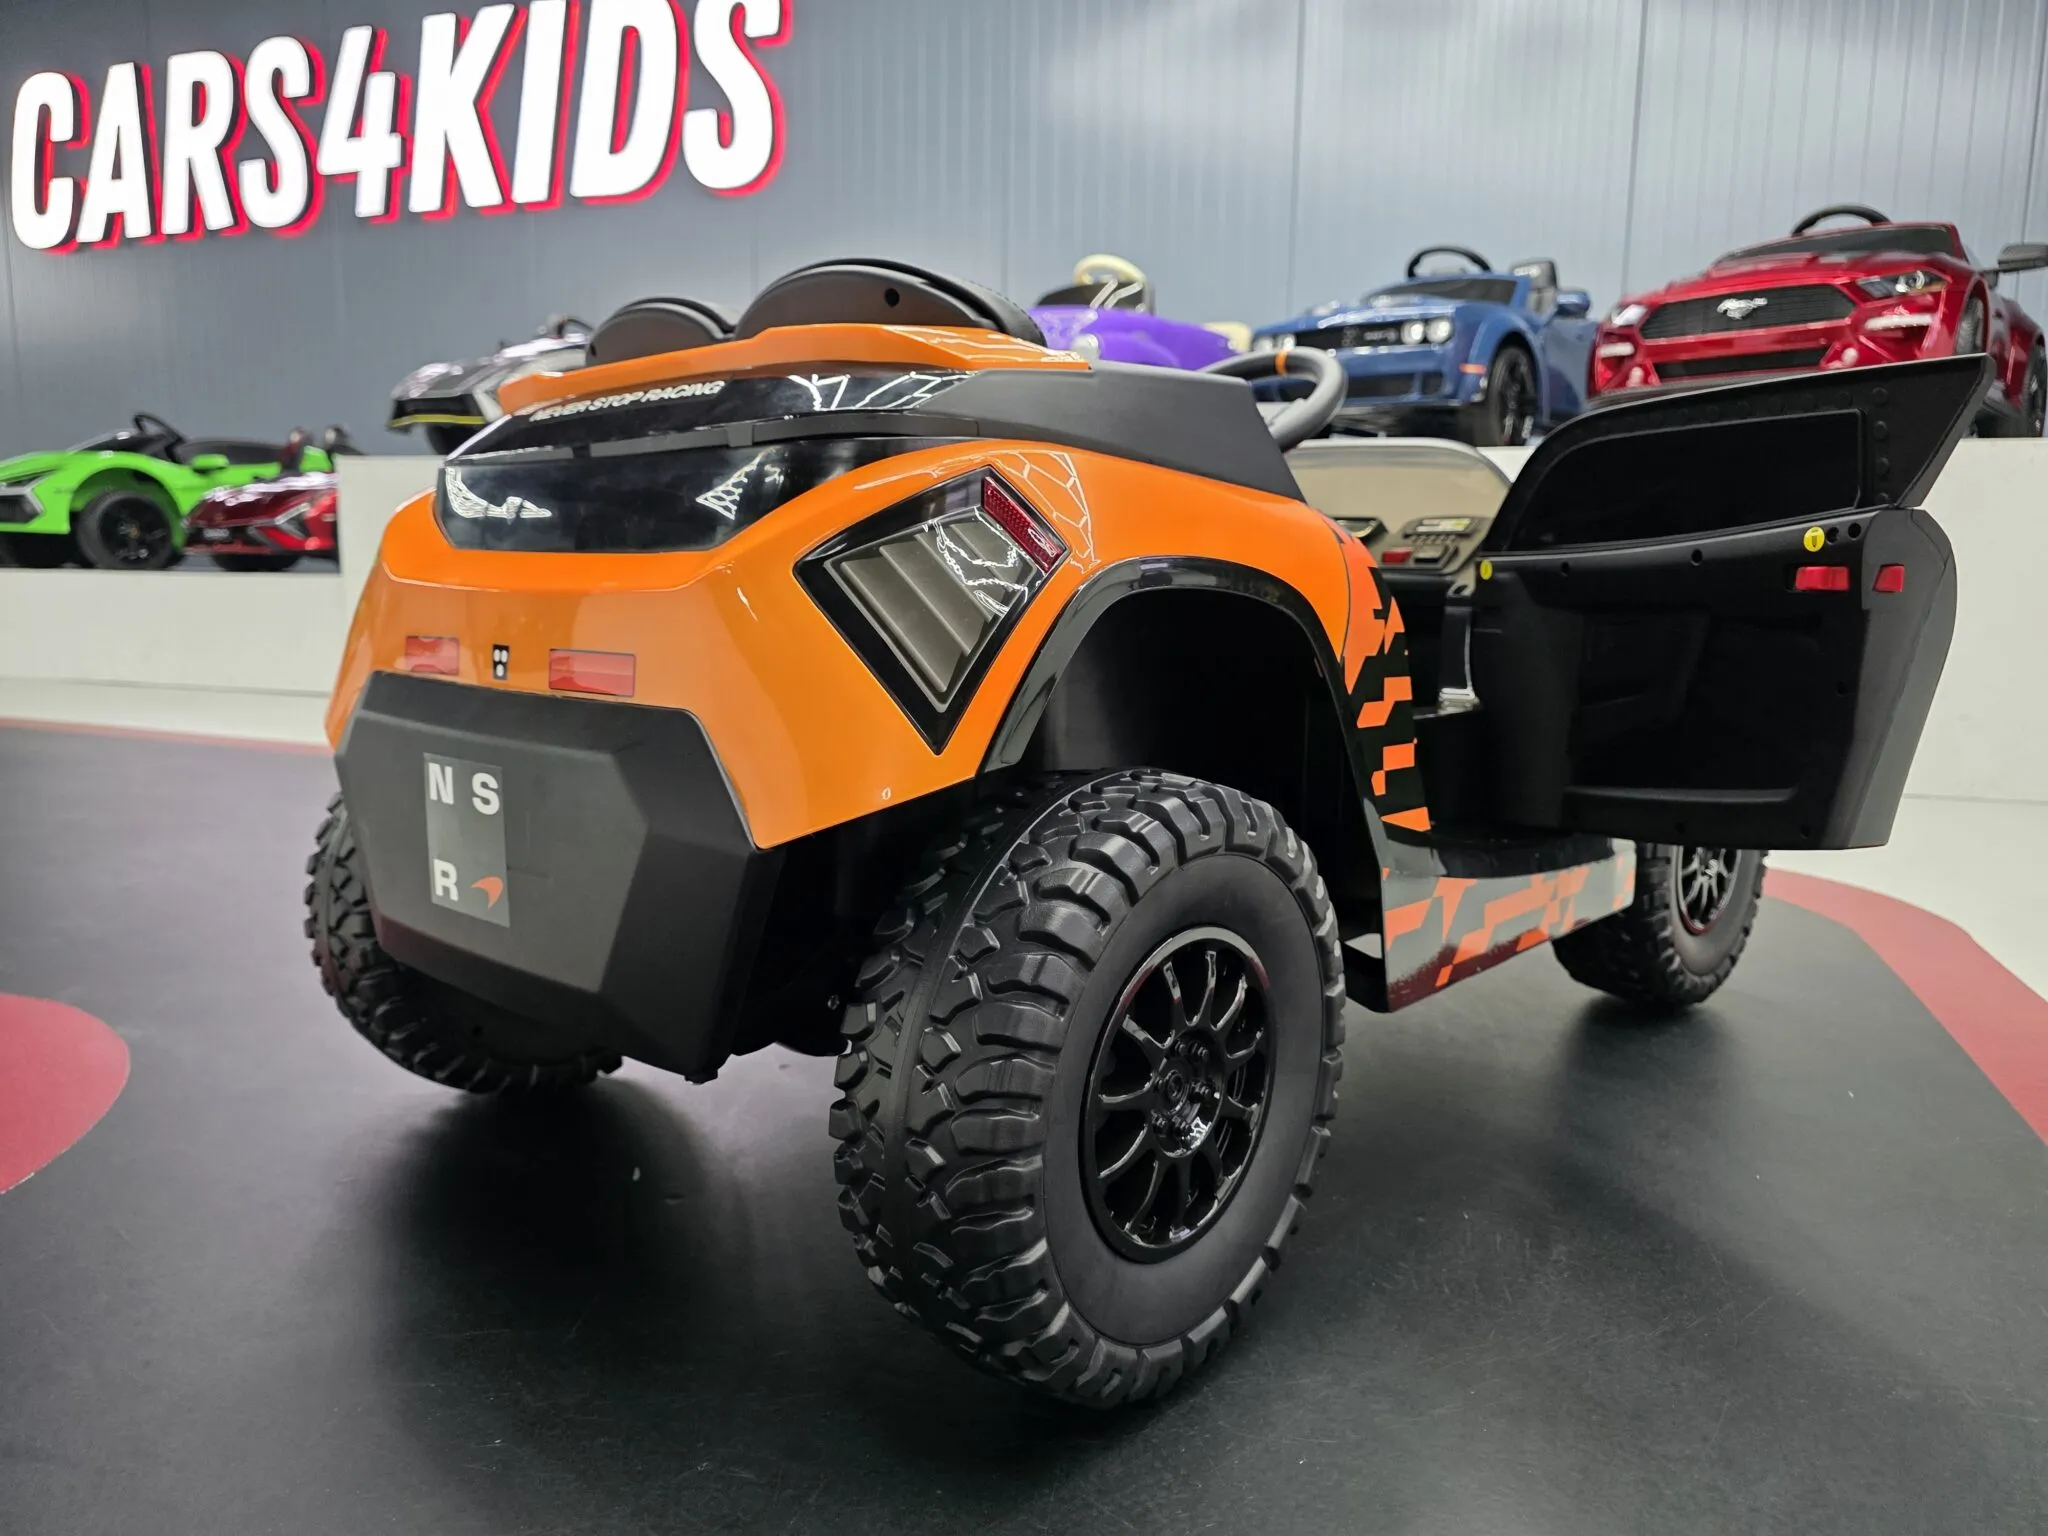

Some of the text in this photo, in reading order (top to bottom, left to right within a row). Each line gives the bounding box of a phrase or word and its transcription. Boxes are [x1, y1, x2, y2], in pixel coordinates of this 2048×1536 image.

[11, 0, 785, 251] CARS4KIDS
[529, 380, 726, 422] NEVER STOP RACING
[428, 762, 500, 815] N S
[433, 858, 459, 902] R
